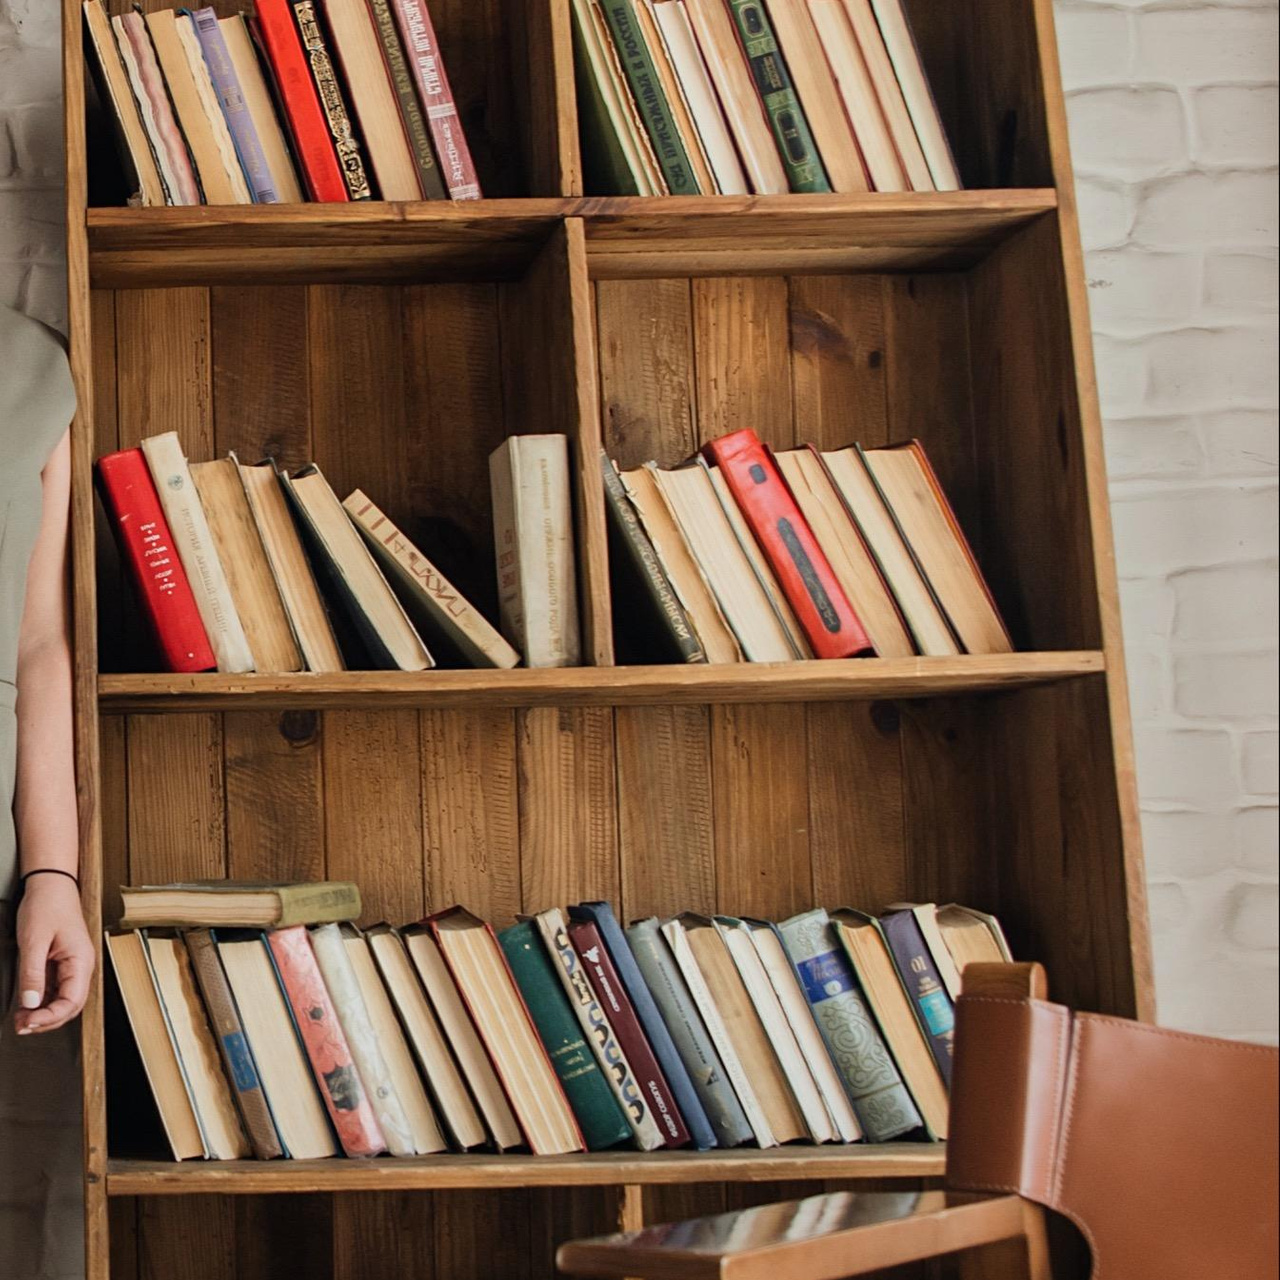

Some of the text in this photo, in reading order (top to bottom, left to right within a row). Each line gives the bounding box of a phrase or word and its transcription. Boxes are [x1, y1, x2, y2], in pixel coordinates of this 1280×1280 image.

[613, 6, 640, 58] РОССИИ
[632, 60, 645, 70] В
[640, 72, 677, 158] ПРИСЯЖНЫХ
[405, 551, 466, 618] ПИКУЛЬ
[659, 594, 691, 642] МЫСЛИ
